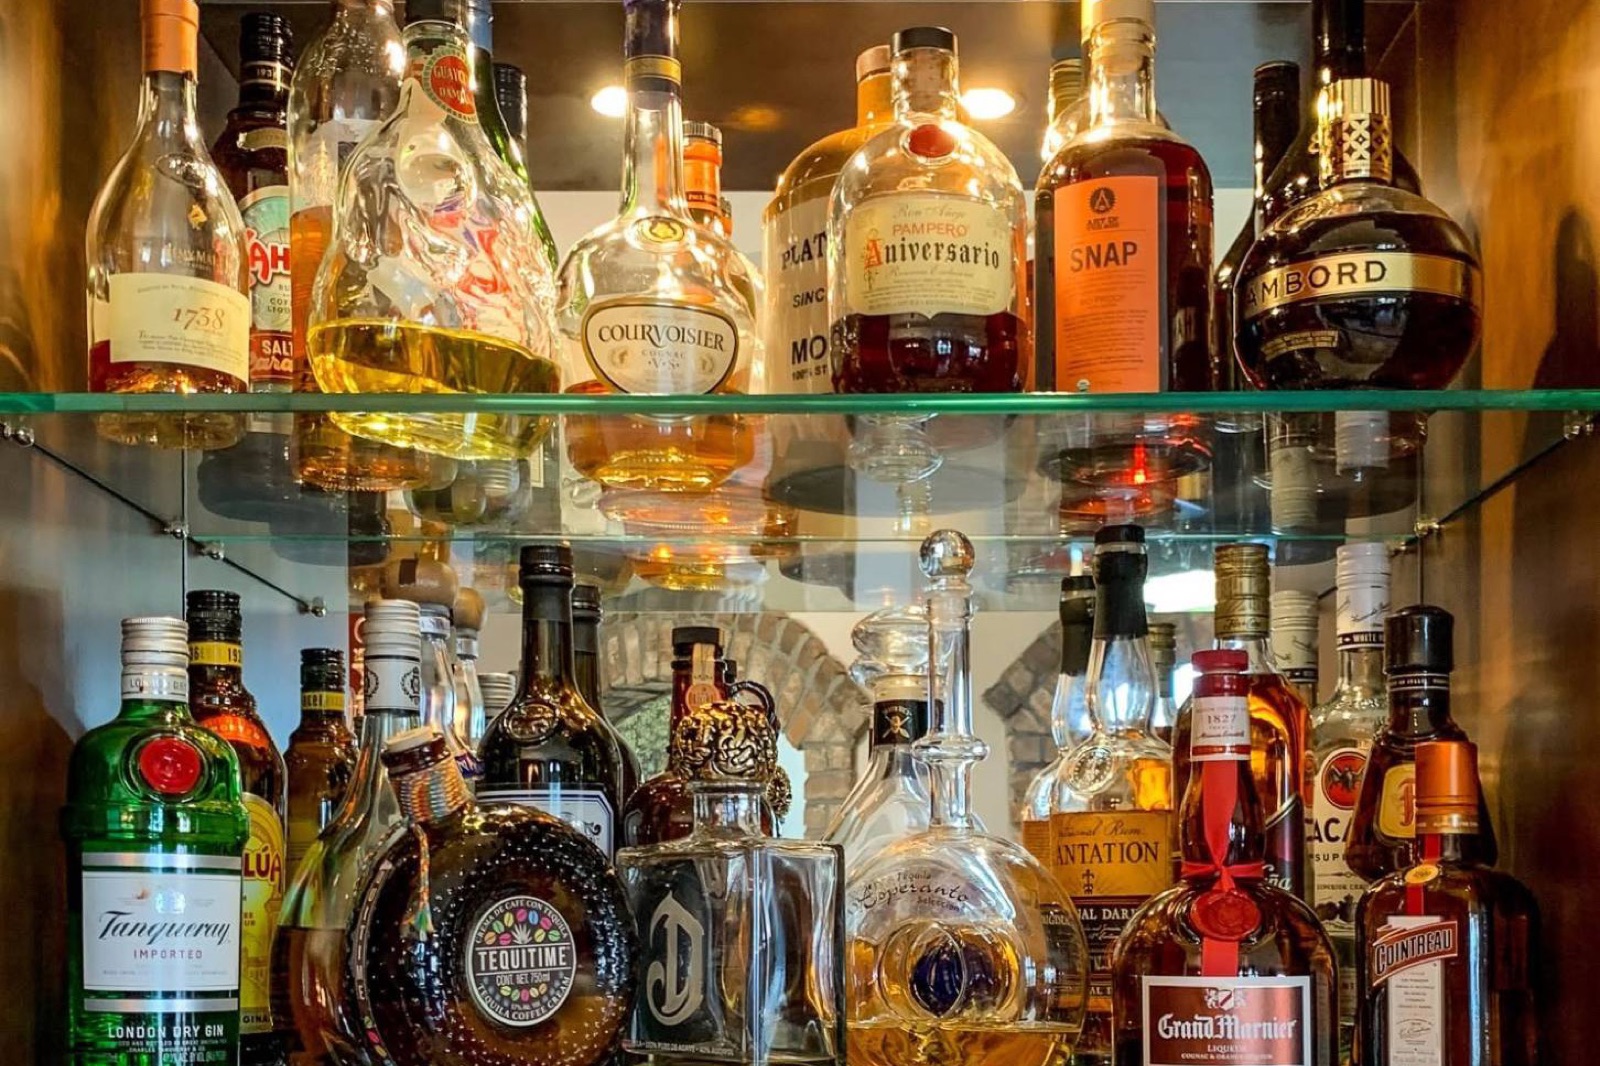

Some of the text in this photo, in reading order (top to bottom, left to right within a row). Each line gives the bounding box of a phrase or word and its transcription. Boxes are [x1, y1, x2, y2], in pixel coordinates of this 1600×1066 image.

[892, 222, 968, 238] PAMPERO
[864, 237, 999, 269] Aniversario
[1070, 241, 1138, 273] SNAP
[792, 288, 825, 308] SINC
[173, 307, 225, 330] 1738
[598, 324, 724, 352] COURVOISIER
[792, 335, 827, 365] MO
[244, 846, 282, 894] LÚA
[99, 910, 231, 945] Tanqueray
[475, 915, 495, 943] CREMA
[494, 905, 504, 916] DE
[526, 900, 543, 910] CON
[543, 908, 568, 938] TEQUILA
[133, 949, 203, 959] IMPORTED
[478, 946, 567, 971] TEQUITIME
[1375, 928, 1452, 976] COINTREAU
[476, 976, 571, 1021] TEQUILA COFFEE CREAM
[108, 1024, 224, 1038] LONDON DRY GIN
[1158, 1013, 1297, 1039] Grand Marnier
